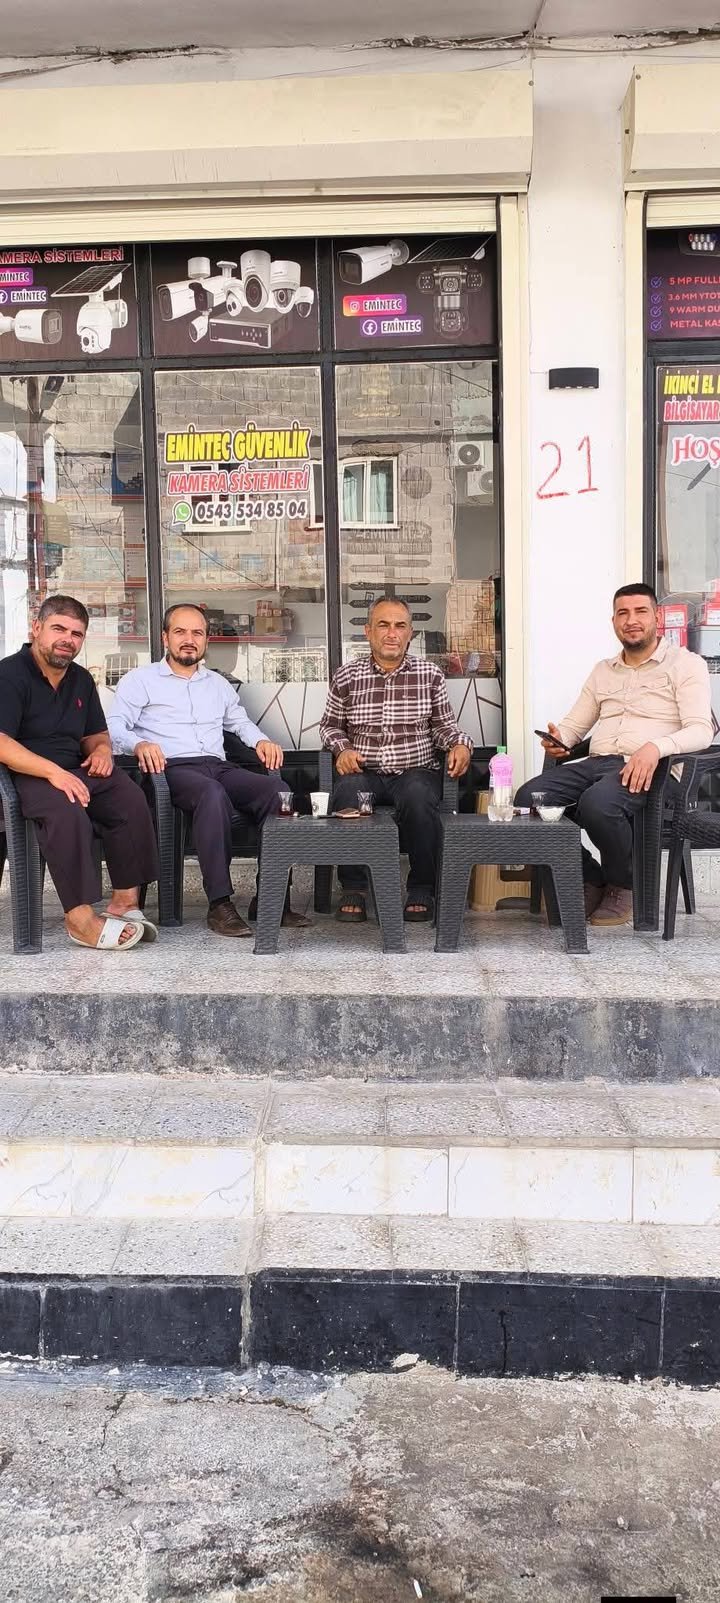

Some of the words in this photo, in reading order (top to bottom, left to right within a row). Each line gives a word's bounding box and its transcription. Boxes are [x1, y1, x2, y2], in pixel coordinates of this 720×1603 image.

[0, 250, 42, 264] MERA
[44, 247, 124, 263] SİSTEMLERİ
[669, 277, 676, 286] 5
[677, 276, 693, 285] MP
[694, 275, 720, 285] FULL
[11, 289, 47, 302] EMİNTEC
[667, 293, 680, 301] 3.6
[682, 292, 698, 301] MM
[363, 298, 402, 312] EMİNTEC
[669, 306, 676, 314] 9
[677, 305, 706, 314] WARM
[381, 319, 422, 333] EMİNTEC
[670, 319, 703, 328] METAL
[664, 370, 700, 394] İKİNCİ
[701, 374, 715, 394] EL
[664, 396, 720, 422] BİLGİSAYAR
[166, 424, 232, 462] EMİNTEC
[233, 421, 311, 460] GÜVENLİK
[536, 435, 599, 499] 21
[169, 472, 229, 494] KAMERA
[229, 466, 311, 493] SİSTEMLERİ
[197, 501, 232, 519] 0543
[236, 502, 263, 518] 534
[266, 501, 284, 518] 85
[288, 500, 306, 517] 04
